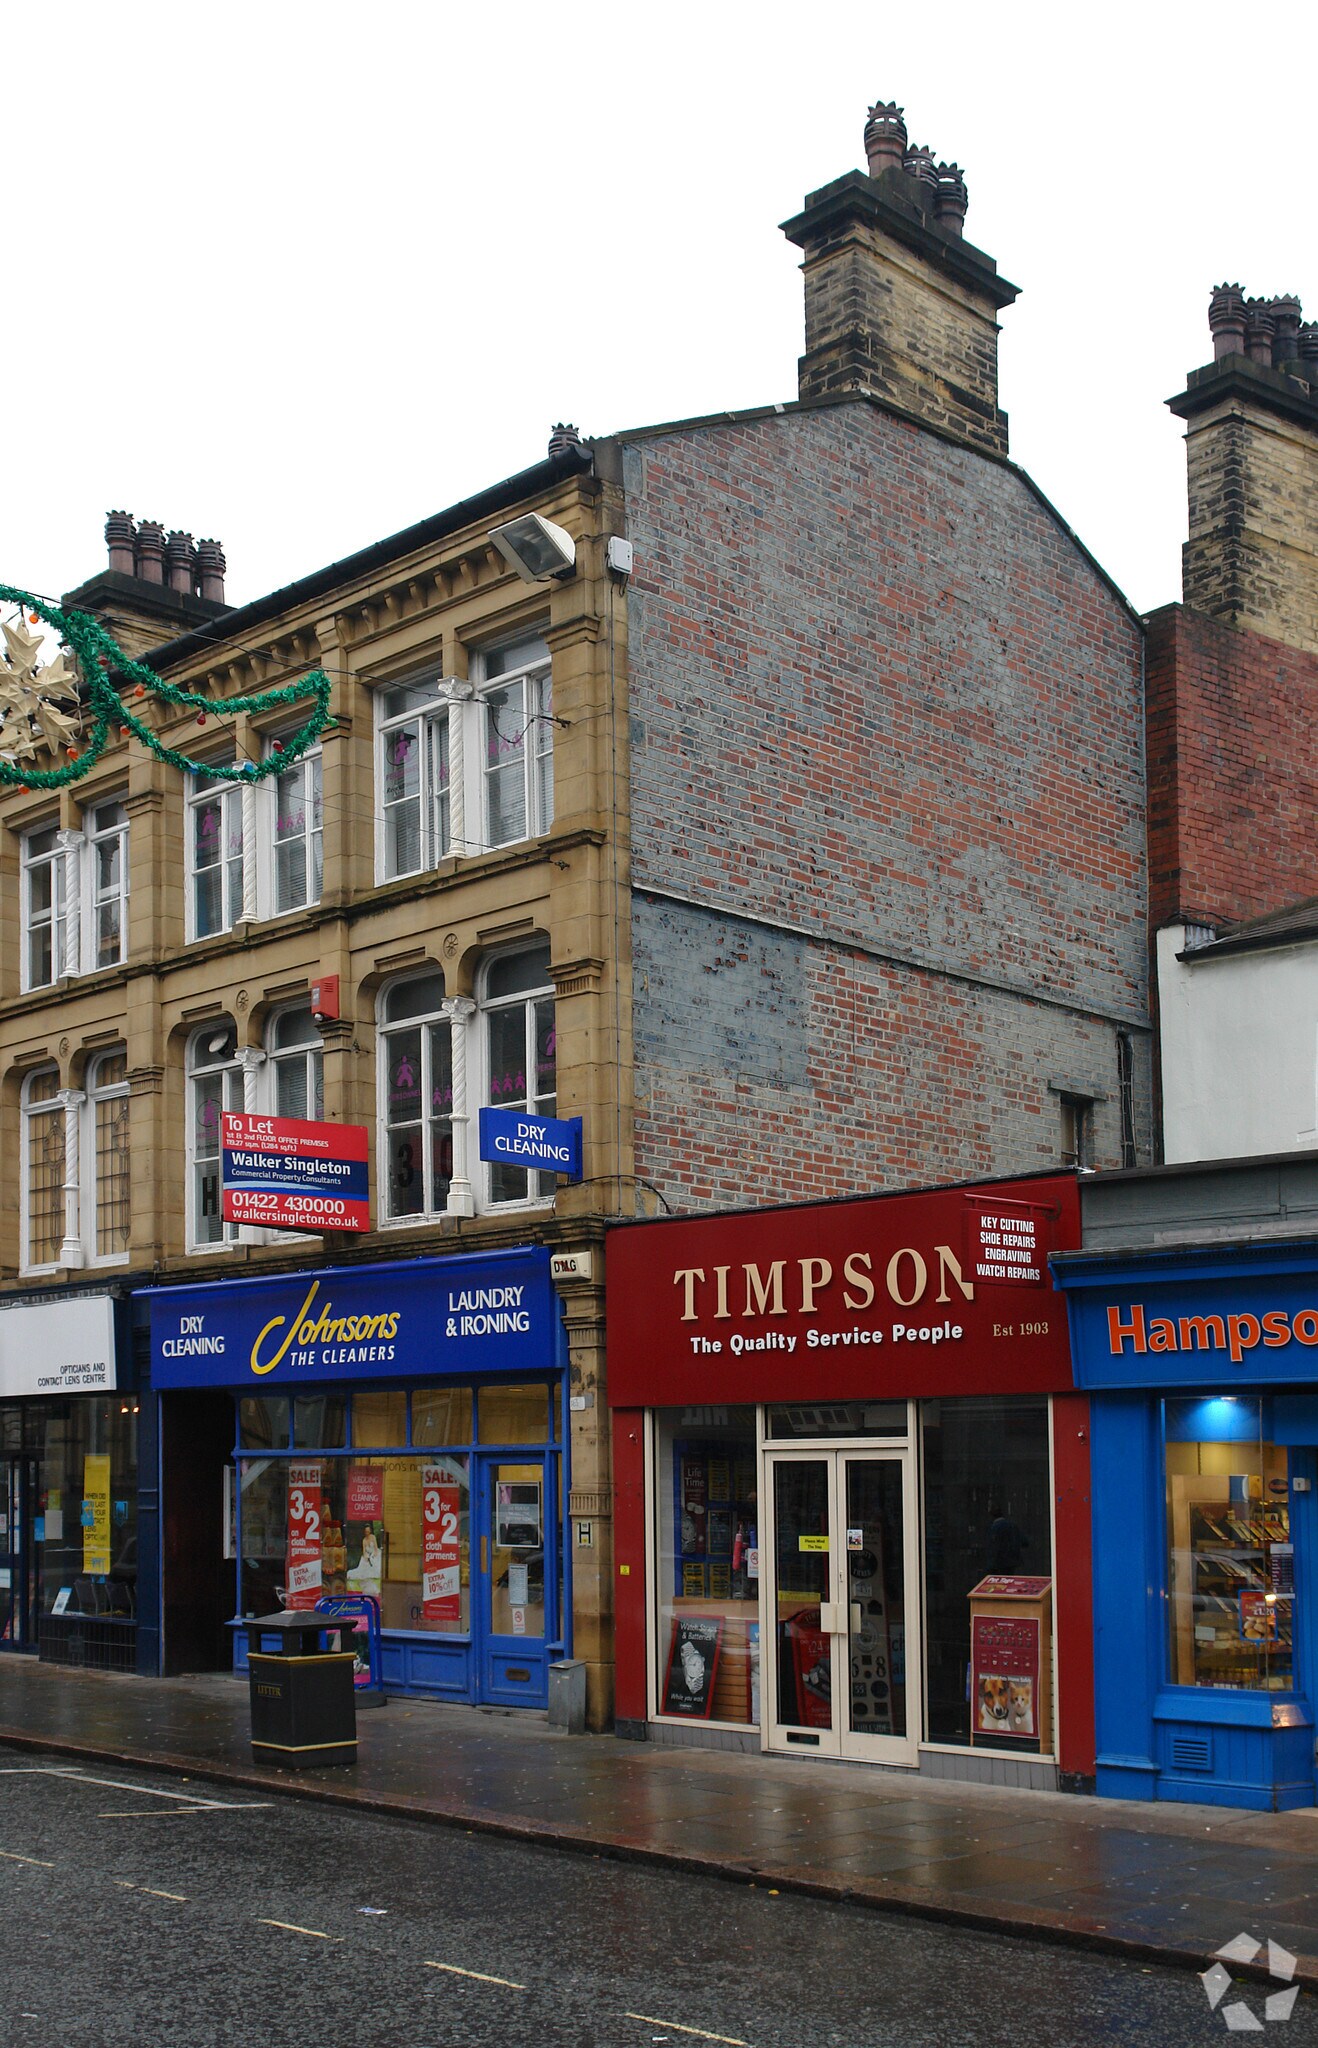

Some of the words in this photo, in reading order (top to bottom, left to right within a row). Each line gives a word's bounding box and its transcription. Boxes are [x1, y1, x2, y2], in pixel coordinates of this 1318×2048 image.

[225, 1114, 243, 1131] To
[248, 1117, 274, 1135] Let
[517, 1123, 547, 1141] DRY
[256, 1134, 277, 1143] FLOOR
[278, 1136, 299, 1145] OFFICE
[299, 1138, 329, 1148] PREMISES
[494, 1136, 570, 1162] CLEANING
[231, 1152, 282, 1169] Walker
[284, 1157, 351, 1176] Singleton
[231, 1168, 271, 1179] Commercial
[272, 1171, 302, 1183] Property
[302, 1174, 341, 1185] Consultants
[231, 1192, 278, 1210] 01422
[284, 1196, 345, 1215] 430000
[232, 1208, 359, 1228] walkersingleton.co.uk
[980, 1215, 998, 1229] KEY
[999, 1218, 1035, 1233] CUTTING
[979, 1231, 1001, 1246] SHOE
[1002, 1233, 1036, 1249] REPAIRS
[984, 1247, 1032, 1264] ENGRAVING
[976, 1263, 1006, 1278] WATCH
[1006, 1266, 1041, 1281] REPAIRS
[673, 1244, 975, 1321] TIMPSON
[448, 1286, 524, 1312] LAUNDRY
[180, 1316, 205, 1335] DRY
[250, 1280, 401, 1375] Johnsons
[445, 1317, 458, 1337] &
[460, 1311, 530, 1336] IRONING
[992, 1323, 1014, 1337] Est
[1019, 1321, 1049, 1336] 1903
[162, 1336, 225, 1358] CLEANING
[691, 1336, 722, 1354] The
[729, 1330, 798, 1356] Quality
[806, 1326, 884, 1348] Service
[892, 1321, 964, 1347] People
[290, 1351, 316, 1366] THE
[322, 1345, 395, 1365] CLEANERS
[60, 1363, 91, 1375] OPTICIANS
[92, 1362, 106, 1373] AND
[38, 1375, 63, 1388] CONTACT
[64, 1374, 81, 1385] LENS
[82, 1373, 106, 1384] CENTRE
[290, 1468, 320, 1484] SALE!
[352, 1475, 380, 1484] WEDDING
[688, 1467, 702, 1478] Life
[356, 1484, 374, 1494] DRESS
[685, 1477, 705, 1488] Time
[289, 1489, 305, 1520] 3
[304, 1501, 314, 1510] for
[351, 1493, 379, 1503] CLEANING
[354, 1502, 376, 1512] ON-SITE
[424, 1490, 441, 1523] 3
[440, 1502, 452, 1512] for
[305, 1510, 320, 1540] 2
[441, 1512, 458, 1544] 2
[291, 1538, 307, 1547] cloth
[425, 1532, 434, 1541] on
[425, 1541, 442, 1551] cloth
[425, 1552, 457, 1563] garments
[428, 1573, 446, 1584] EXTRA
[257, 1684, 282, 1697] LITTER
